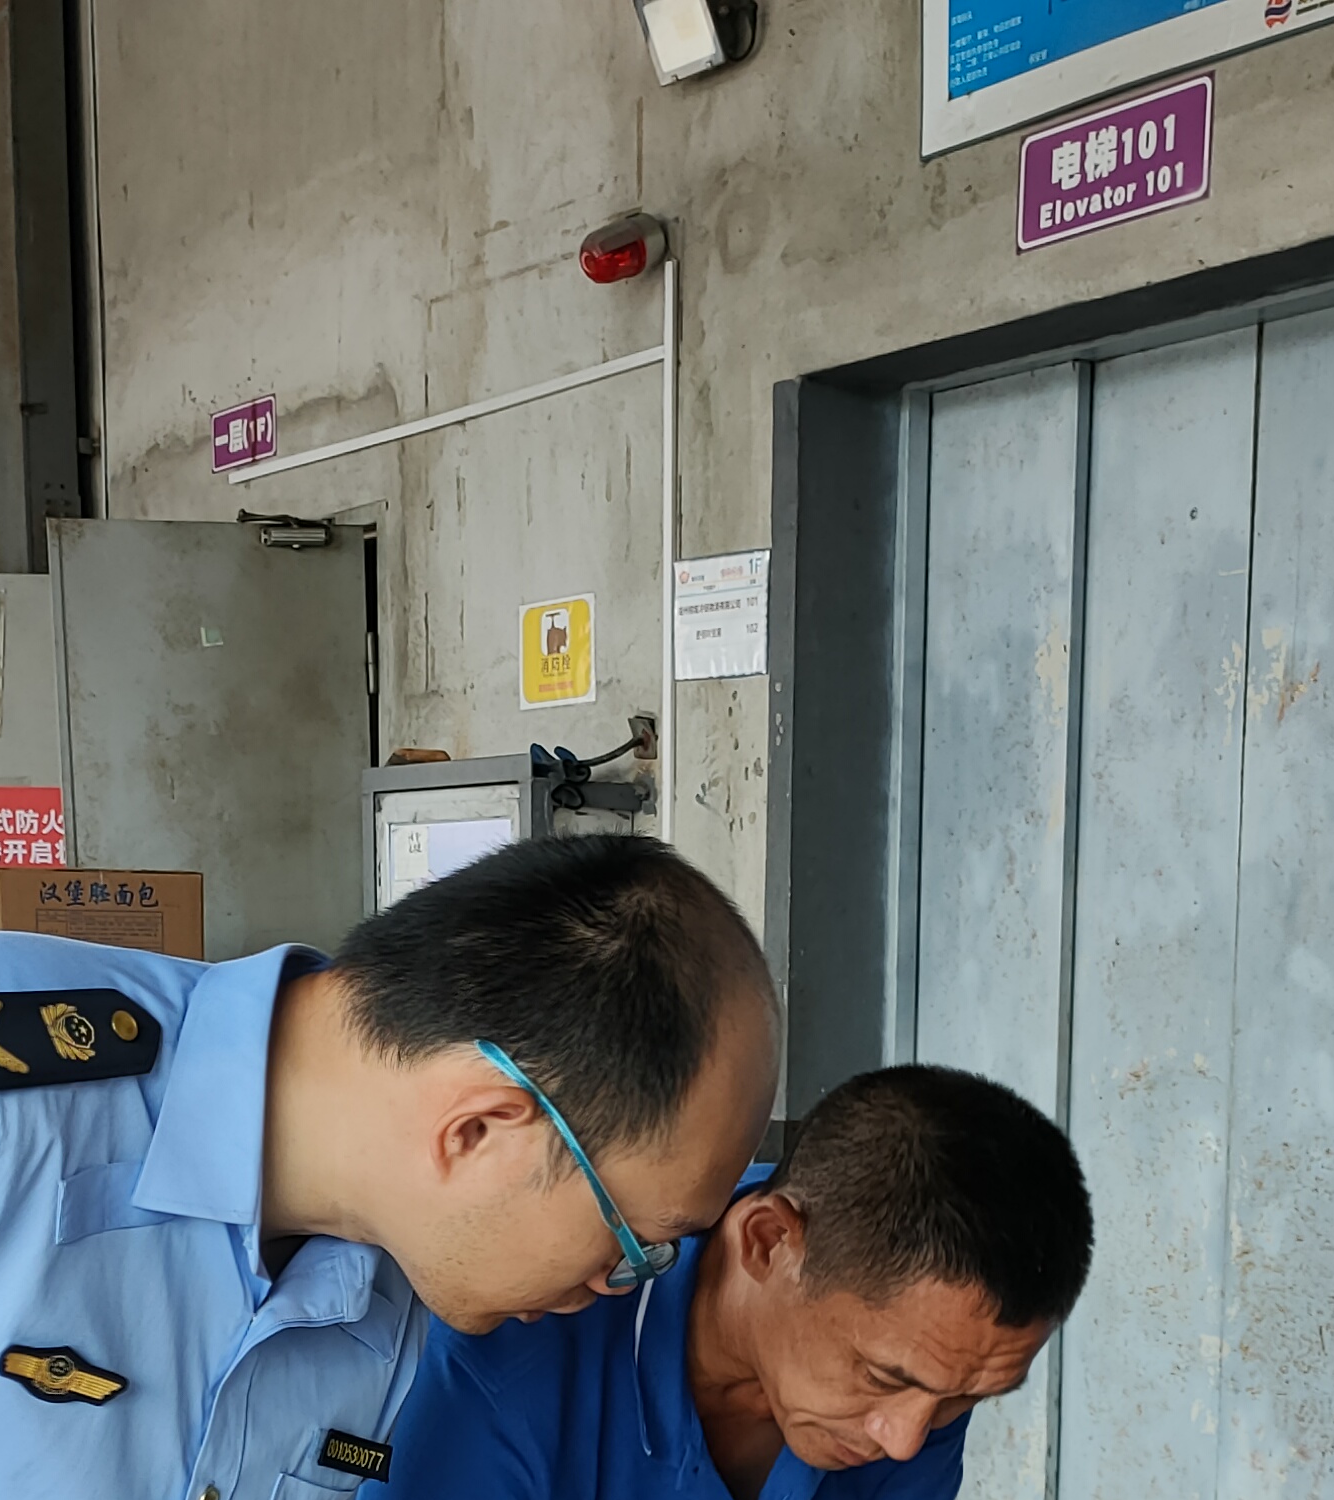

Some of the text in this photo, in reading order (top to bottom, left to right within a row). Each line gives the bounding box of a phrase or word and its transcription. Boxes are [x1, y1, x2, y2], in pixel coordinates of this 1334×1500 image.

[1051, 114, 1177, 191] 电梯101
[1040, 162, 1185, 229] Elevator 101
[215, 411, 272, 453] 一层(1F)
